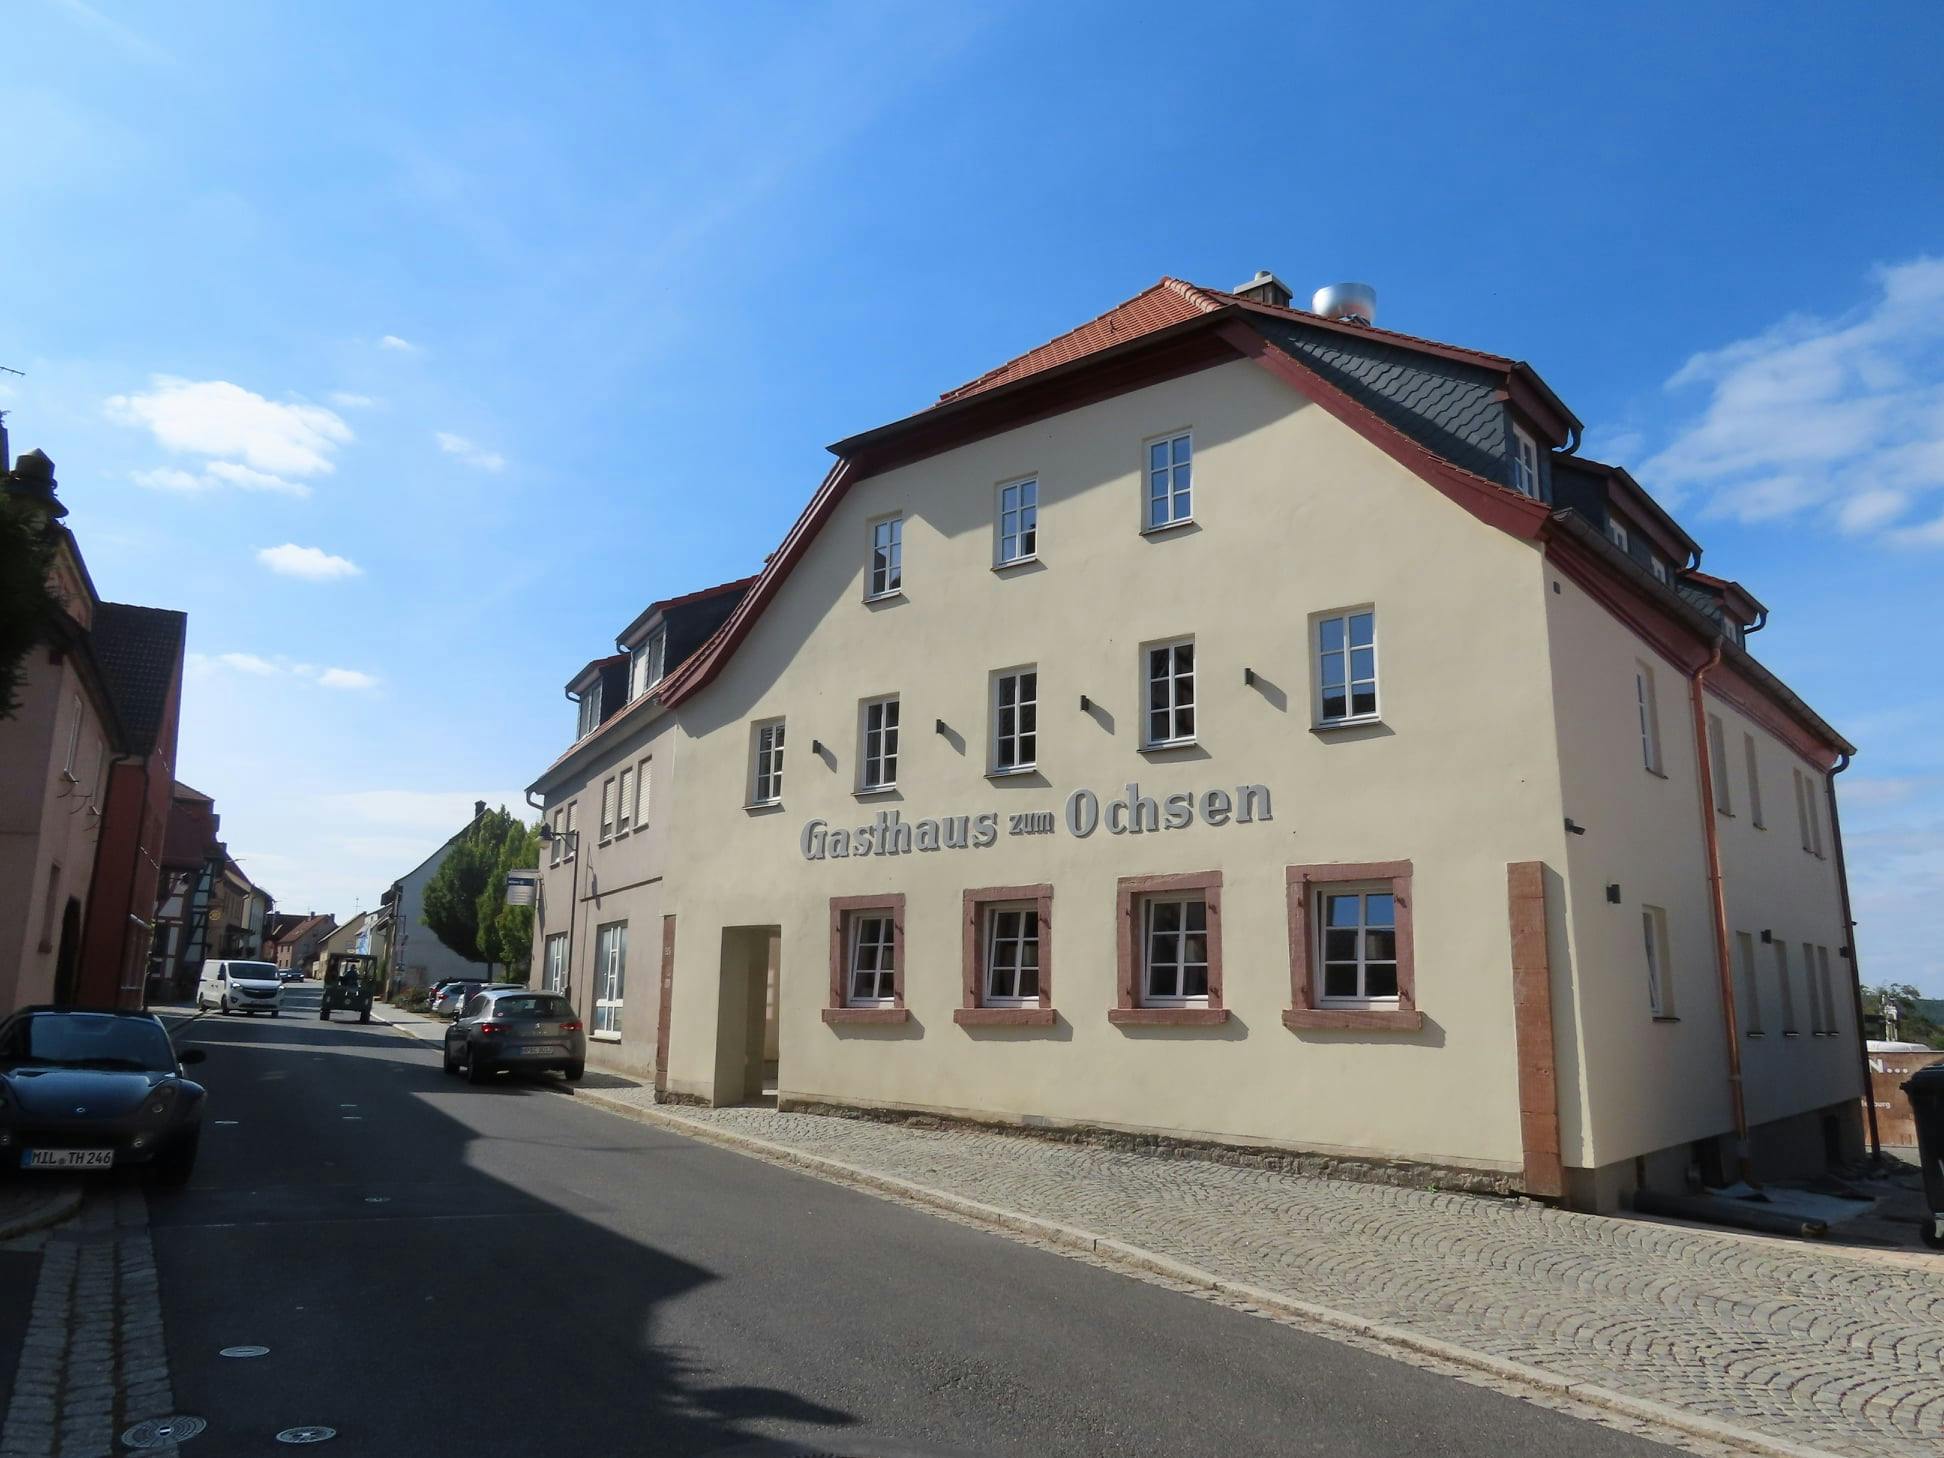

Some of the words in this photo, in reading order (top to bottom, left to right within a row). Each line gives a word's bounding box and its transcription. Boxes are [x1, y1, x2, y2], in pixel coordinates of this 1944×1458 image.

[800, 809, 998, 860] Gasthaus
[1009, 810, 1056, 836] zum
[1065, 782, 1274, 839] Ochsen
[31, 1151, 57, 1165] MIL
[69, 1151, 85, 1164] TH
[86, 1151, 112, 1164] 246
